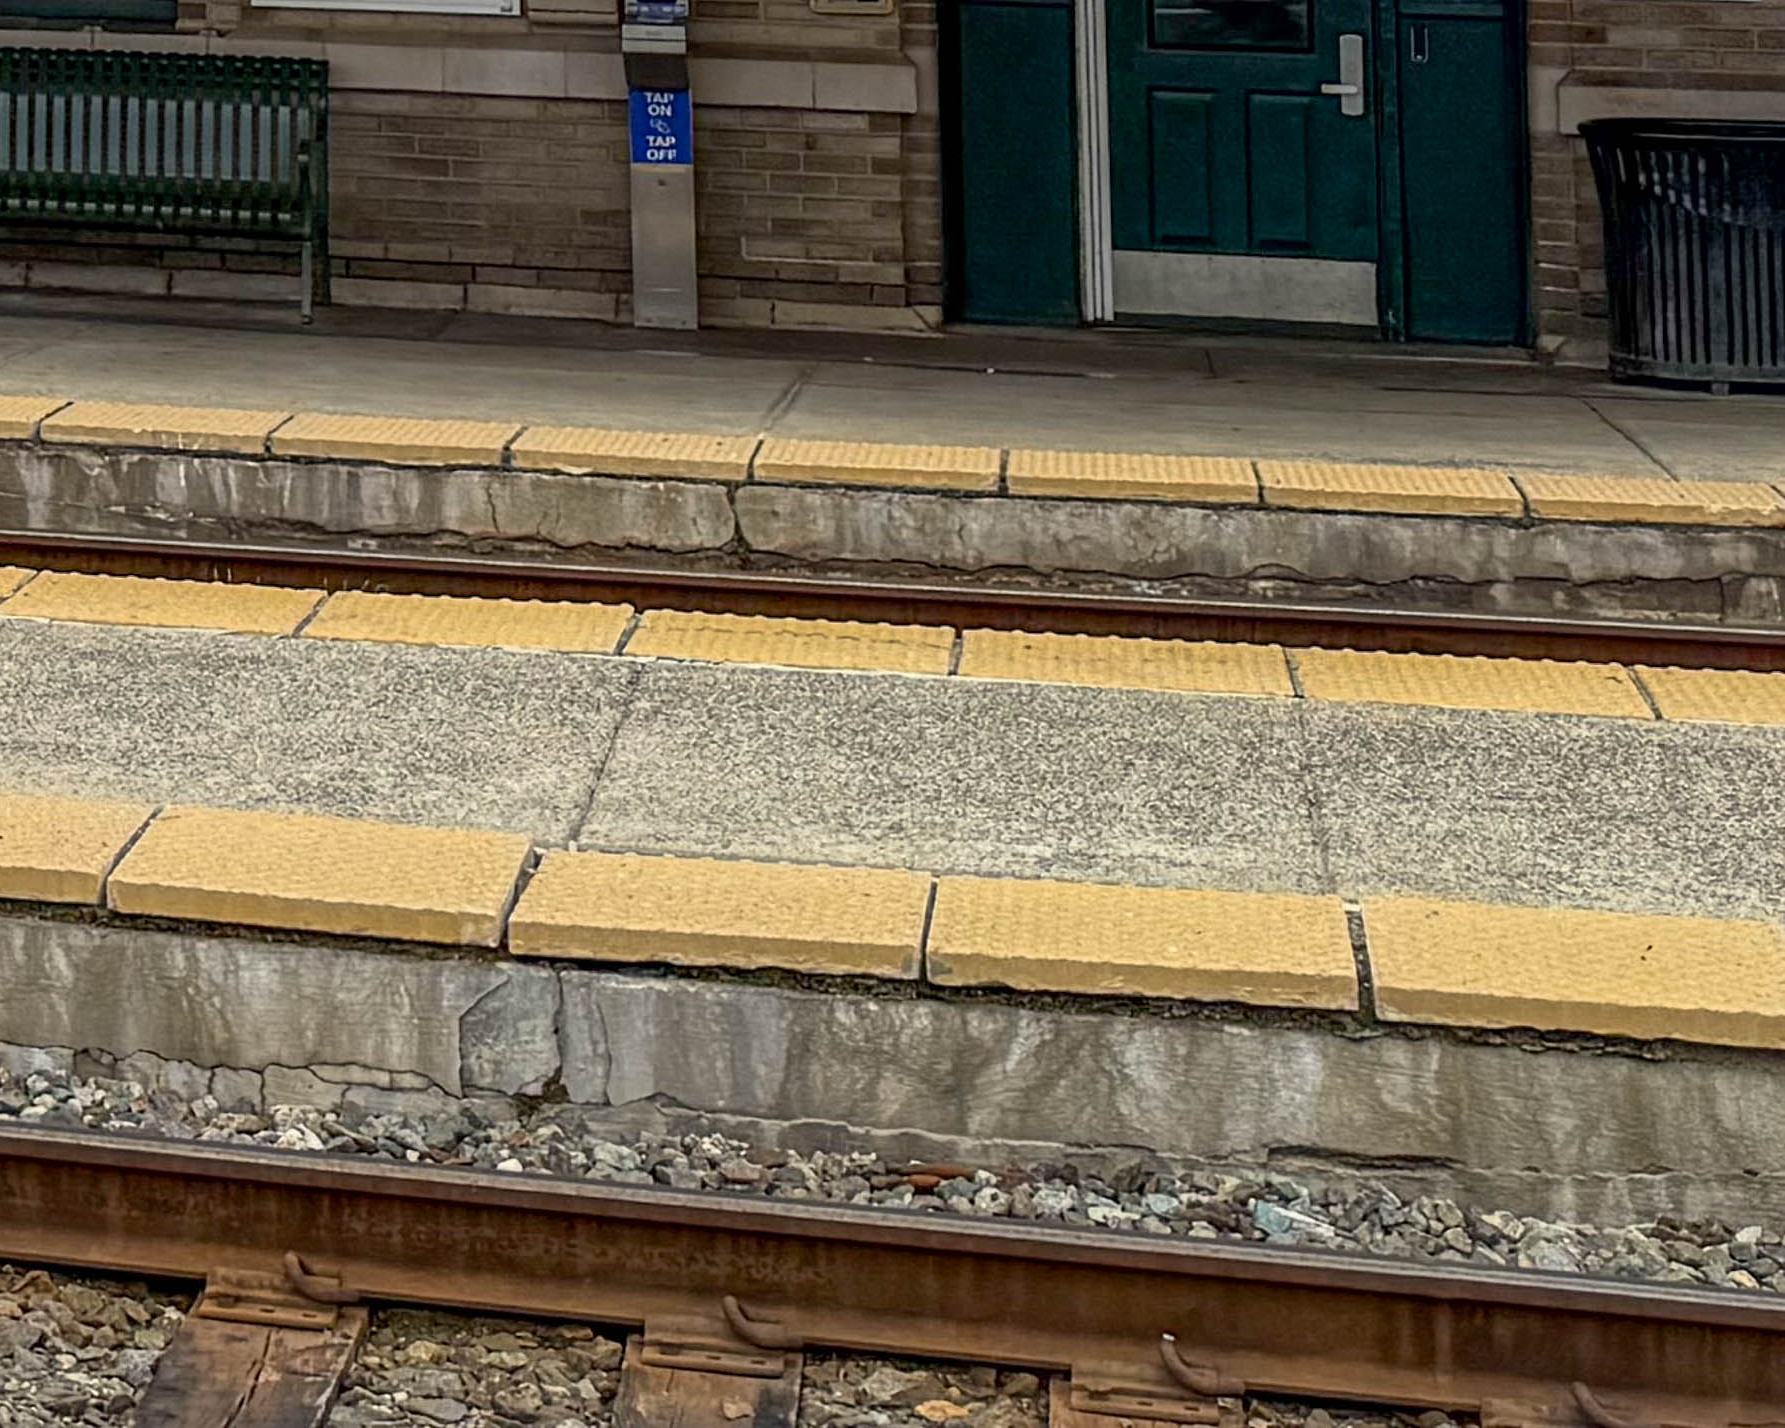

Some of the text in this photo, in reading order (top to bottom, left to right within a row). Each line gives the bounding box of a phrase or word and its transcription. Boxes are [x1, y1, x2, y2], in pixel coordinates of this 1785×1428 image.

[644, 91, 675, 104] TAP
[647, 104, 673, 117] ON
[646, 135, 676, 147] TAP
[646, 148, 677, 161] OFF
